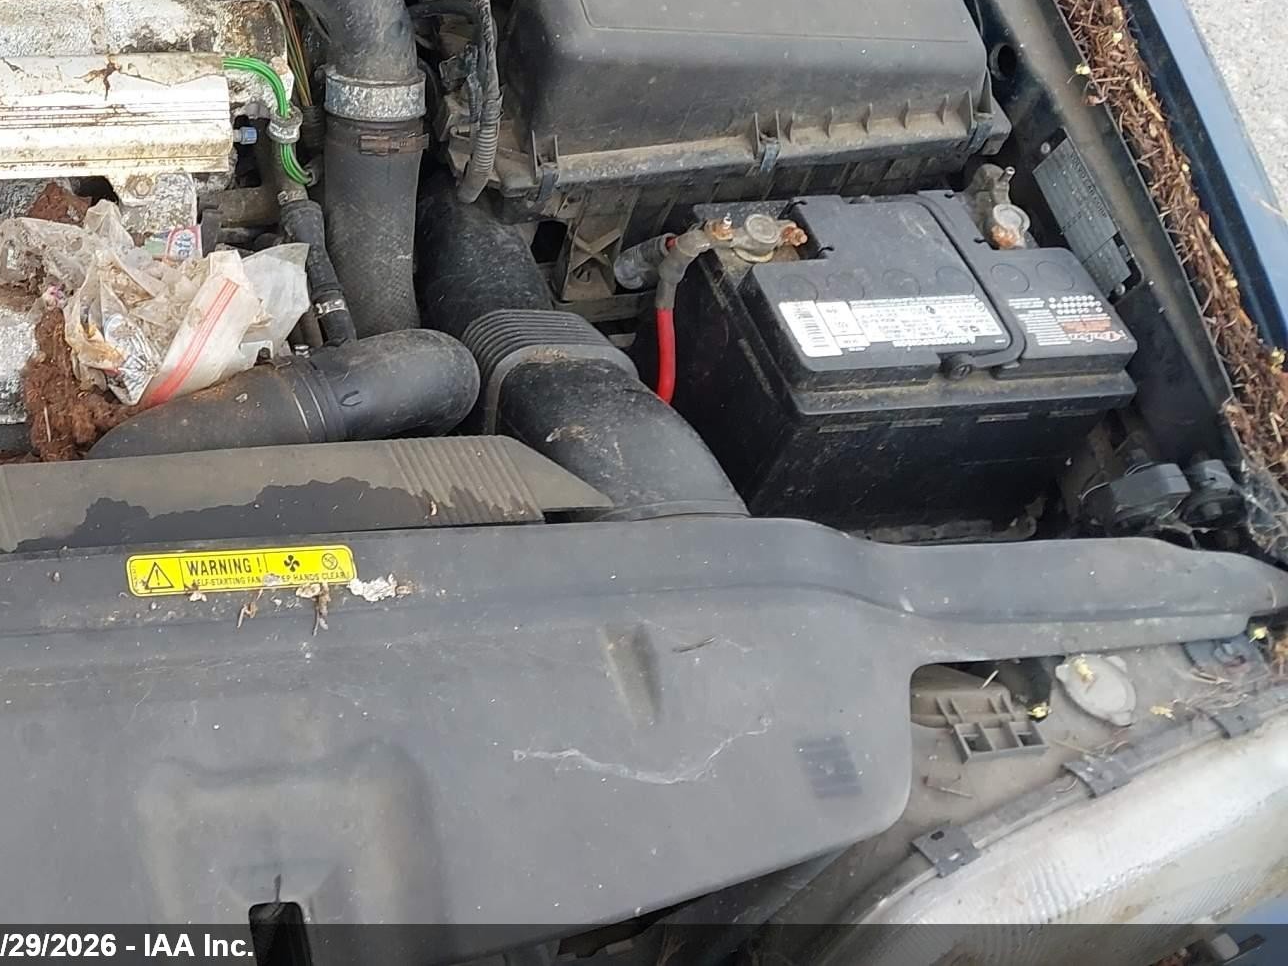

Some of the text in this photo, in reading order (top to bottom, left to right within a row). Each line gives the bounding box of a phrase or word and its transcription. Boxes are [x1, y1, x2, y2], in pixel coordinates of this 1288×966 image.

[186, 558, 252, 576] WARNING
[247, 576, 262, 584] FAN
[293, 573, 320, 582] HANDS
